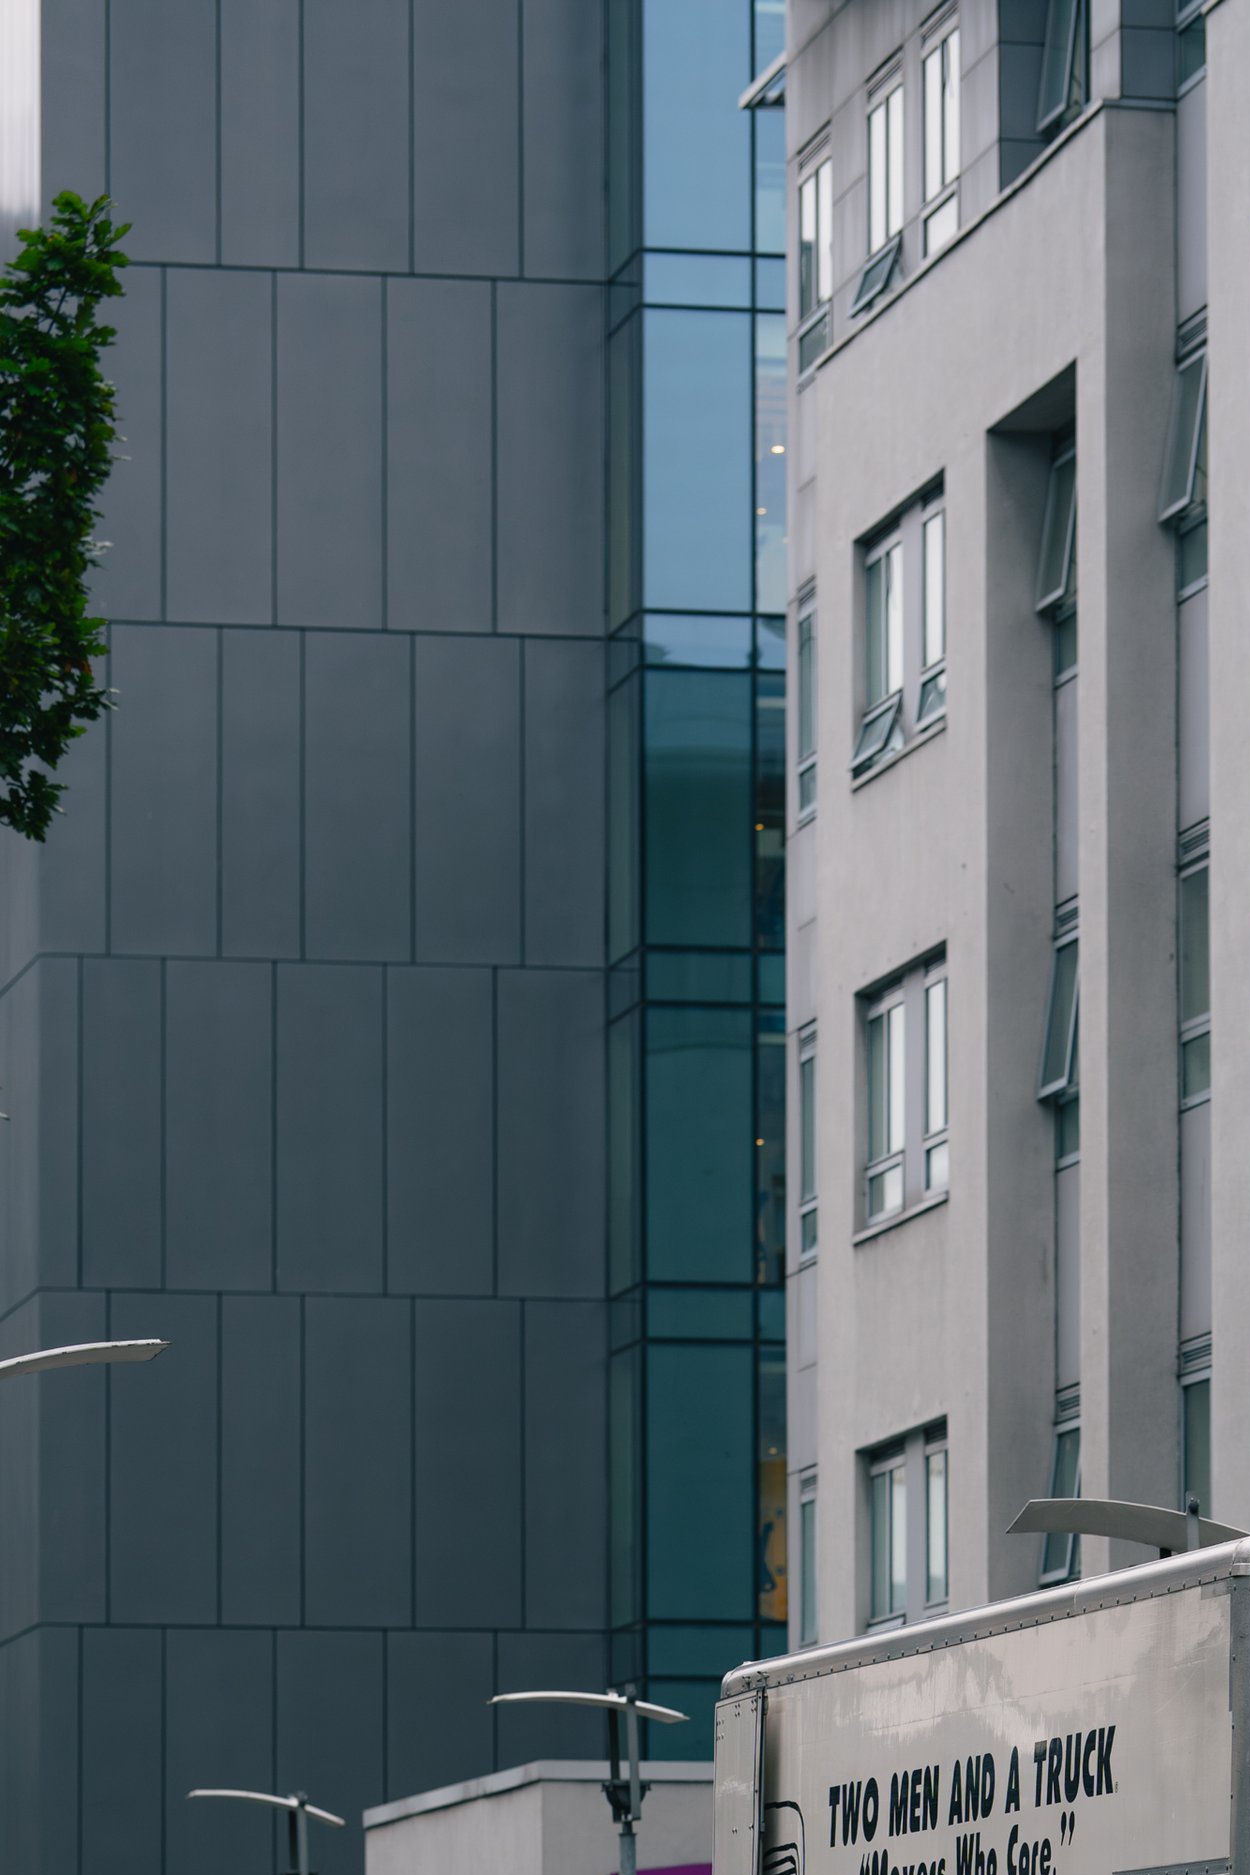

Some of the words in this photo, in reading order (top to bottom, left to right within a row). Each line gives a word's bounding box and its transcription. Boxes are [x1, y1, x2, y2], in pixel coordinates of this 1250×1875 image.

[829, 1776, 879, 1848] TWO
[889, 1764, 939, 1837] MEN
[948, 1752, 996, 1826] AND
[1004, 1746, 1020, 1814] A
